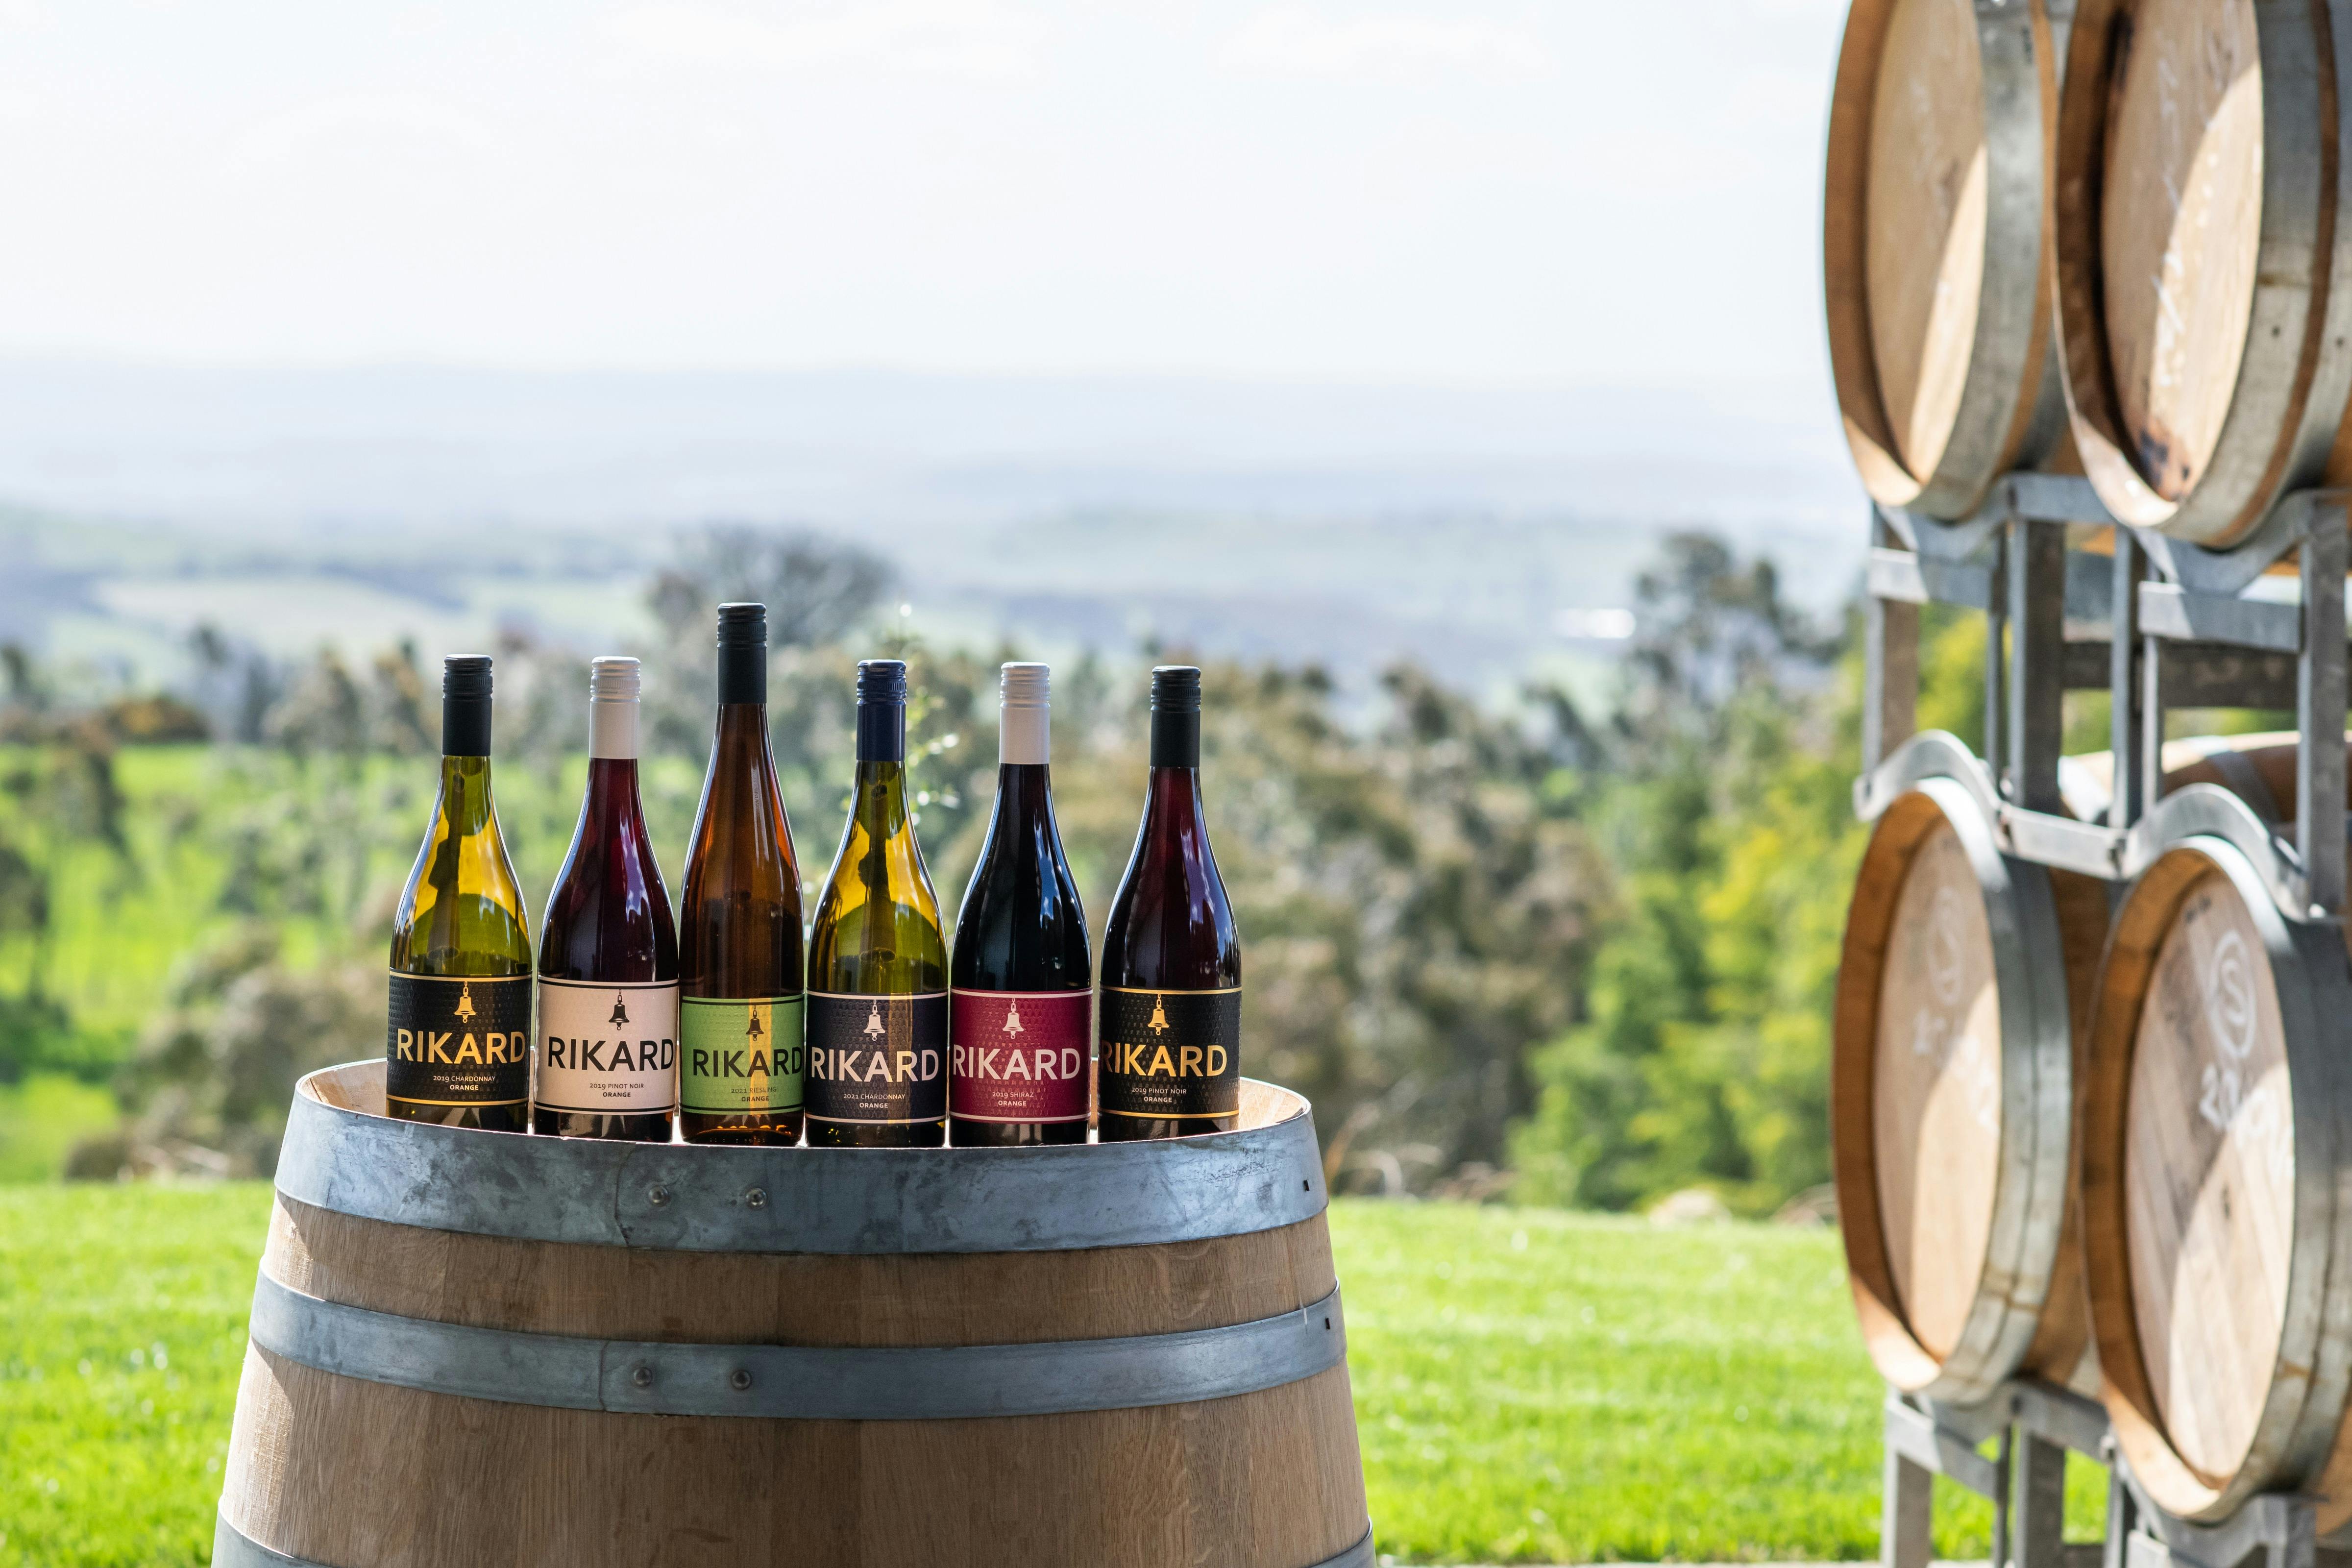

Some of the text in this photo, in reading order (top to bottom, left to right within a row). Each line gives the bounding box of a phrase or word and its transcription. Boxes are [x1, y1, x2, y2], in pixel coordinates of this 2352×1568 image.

[397, 1028, 525, 1064] RIKARD
[548, 1036, 674, 1072] RIKARD
[693, 1046, 803, 1078] RIKARD
[953, 1044, 1080, 1080] RIKARD
[1101, 1039, 1227, 1077] RIKARD
[811, 1047, 939, 1082] RIKARD
